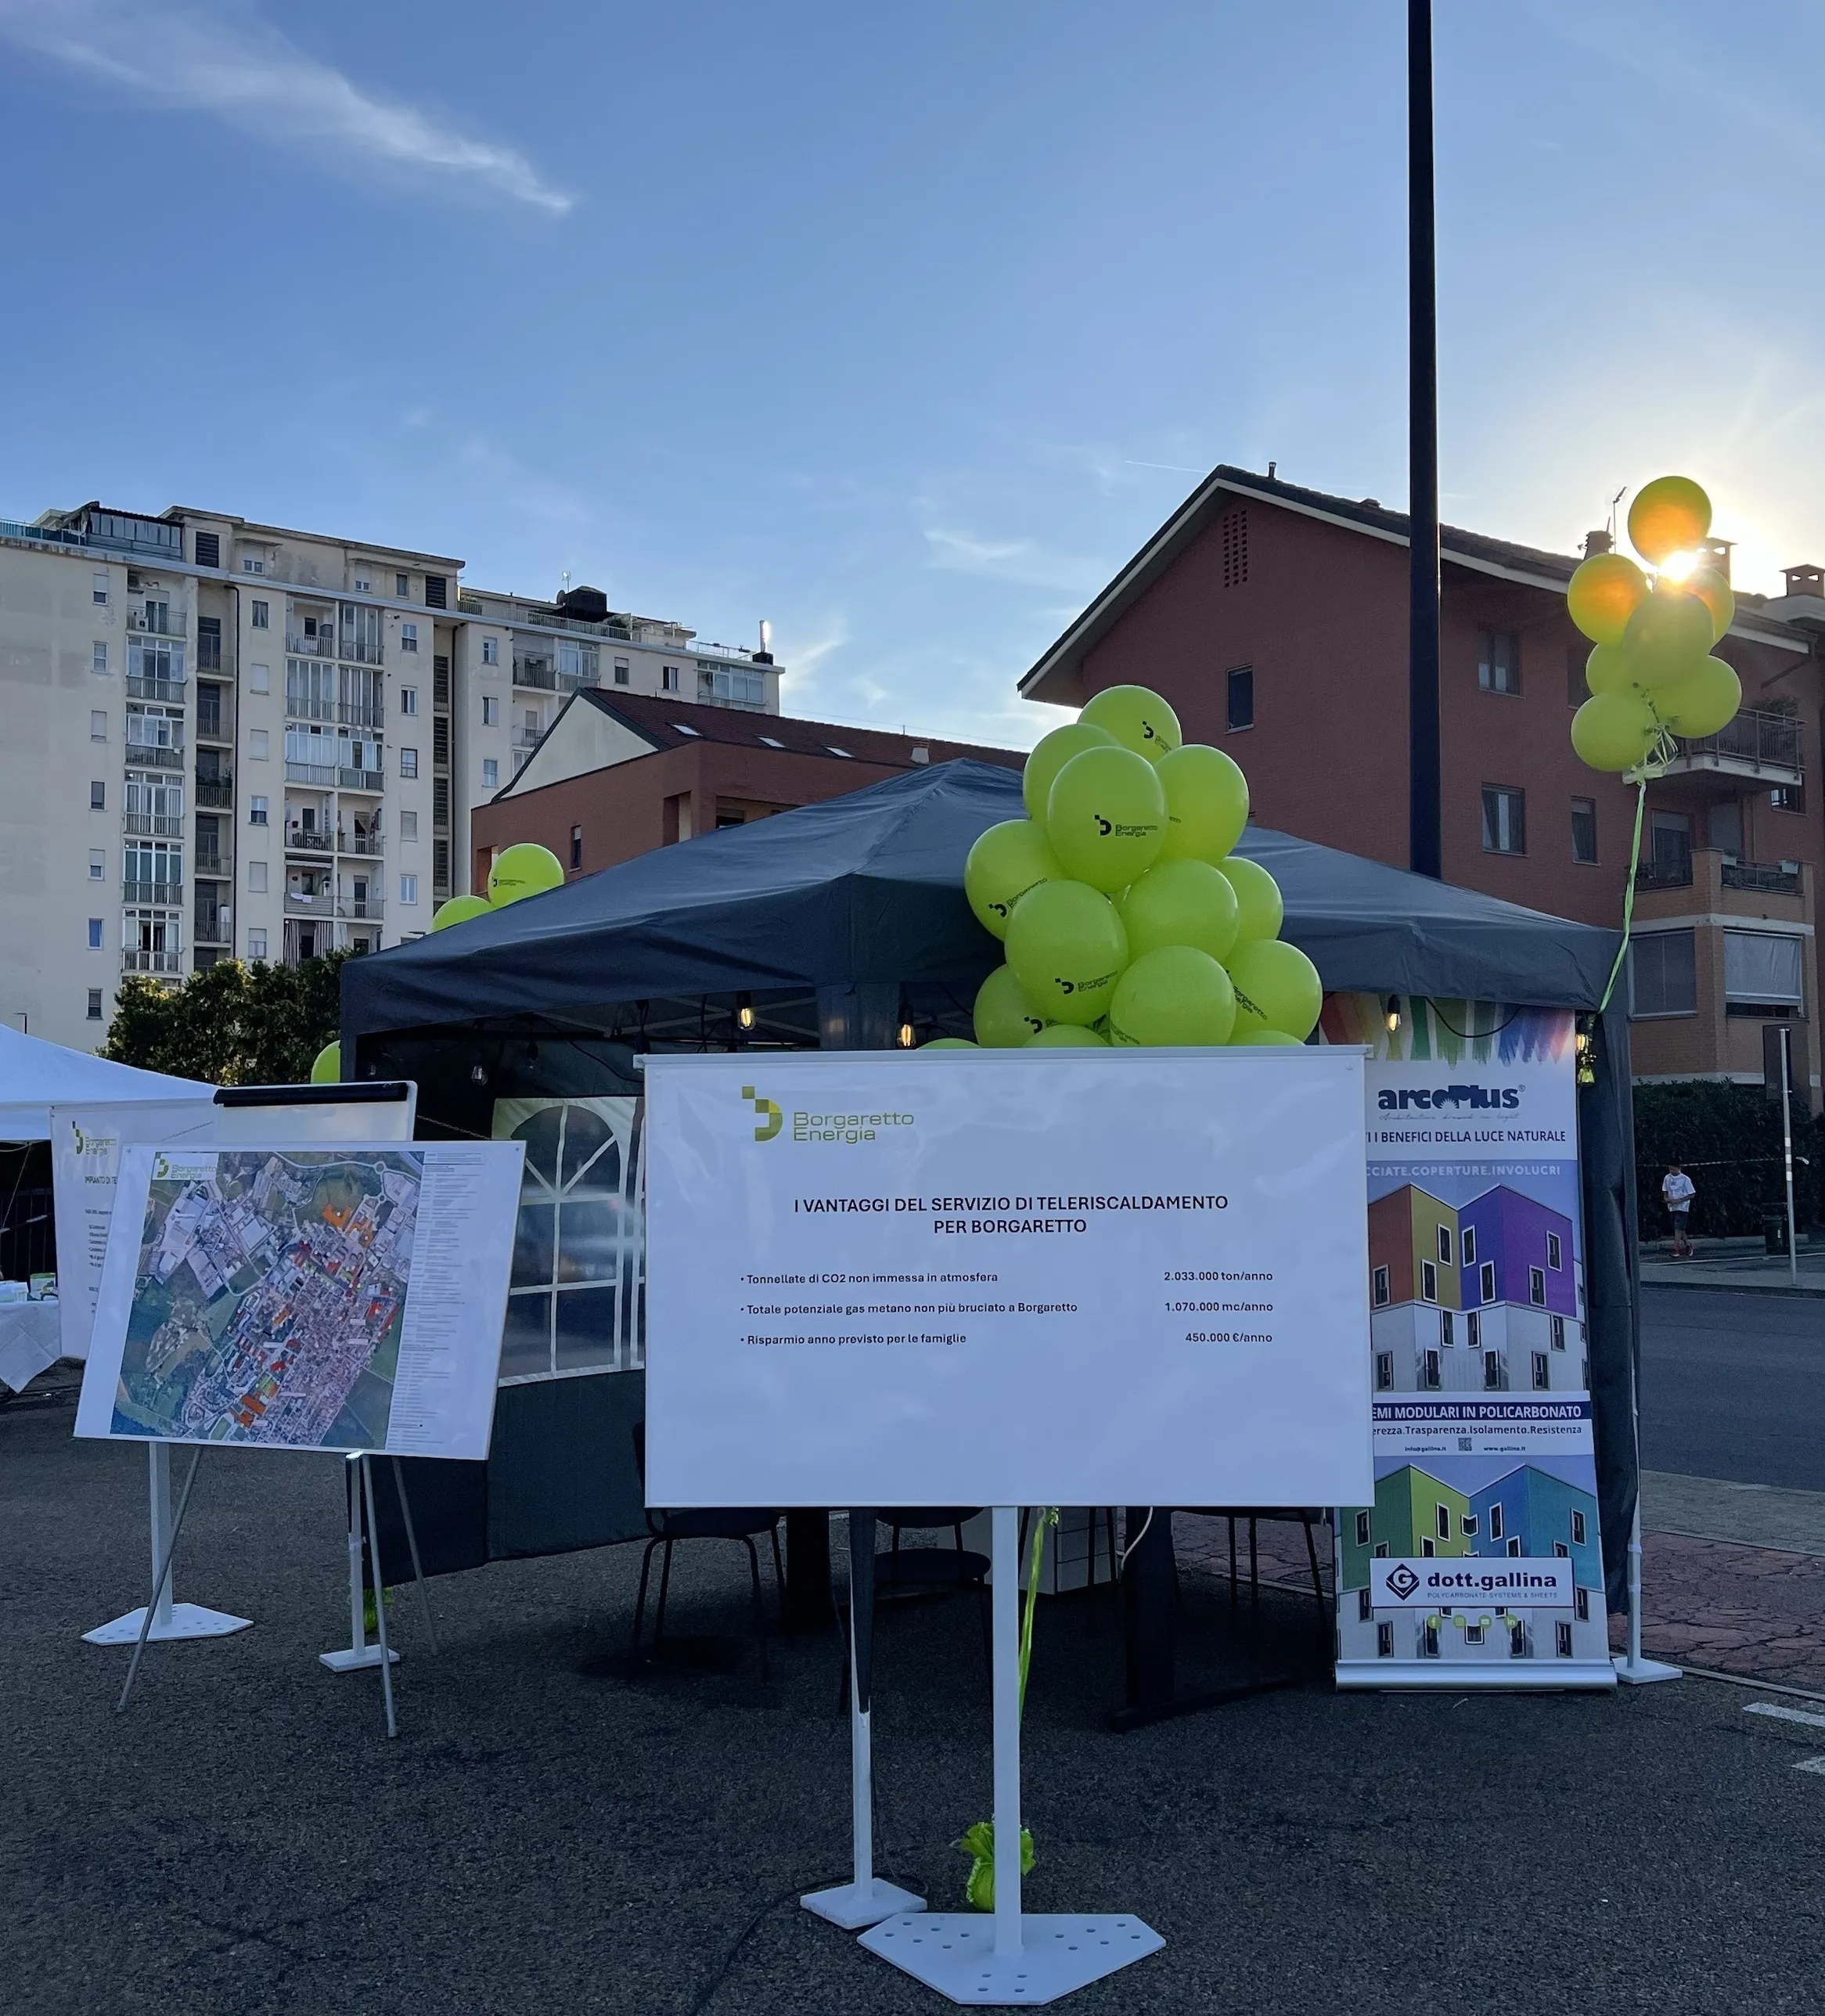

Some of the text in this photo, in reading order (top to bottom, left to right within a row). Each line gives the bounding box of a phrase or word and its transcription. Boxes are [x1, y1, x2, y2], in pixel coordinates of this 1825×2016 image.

[794, 1112, 914, 1129] Borgaretto
[794, 1127, 875, 1144] Energia
[1381, 1131, 1431, 1143] BENEFICI
[1435, 1131, 1471, 1143] DELLA
[1475, 1131, 1504, 1142] LUCE
[1507, 1131, 1566, 1142] NATURALE
[794, 1196, 1228, 1212] I VANTAGGI DEL SERVIZIO DI TELERISCALDAMENTO
[934, 1219, 1087, 1233] PER BORGARETTO
[747, 1274, 806, 1283] Tonnellate
[808, 1274, 819, 1283] di
[822, 1274, 846, 1283] CO2
[873, 1273, 924, 1283] immessa
[927, 1273, 937, 1282] in
[940, 1273, 998, 1282] atmosfera
[1164, 1271, 1273, 1281] 2.033.000 ton/anno
[747, 1305, 781, 1314] Totale
[784, 1304, 843, 1316] potenziale
[845, 1306, 865, 1316] gas
[868, 1305, 912, 1313] metano
[938, 1302, 956, 1314] più
[958, 1303, 1006, 1312] bruciato
[1017, 1302, 1078, 1314] Borgaretto
[1164, 1301, 1274, 1312] 1.070.000 mc/anno
[747, 1335, 805, 1346] Risparmio
[838, 1334, 884, 1345] previsto
[887, 1336, 905, 1345] per
[908, 1334, 919, 1343] le
[920, 1334, 966, 1345] famiglie
[1186, 1333, 1272, 1342] 450.000 €/anno
[1395, 1406, 1460, 1419] MODULARI
[1463, 1406, 1476, 1418] IN
[1479, 1406, 1582, 1418] POLICARBONATO
[1427, 1572, 1557, 1591] dott.gallina
